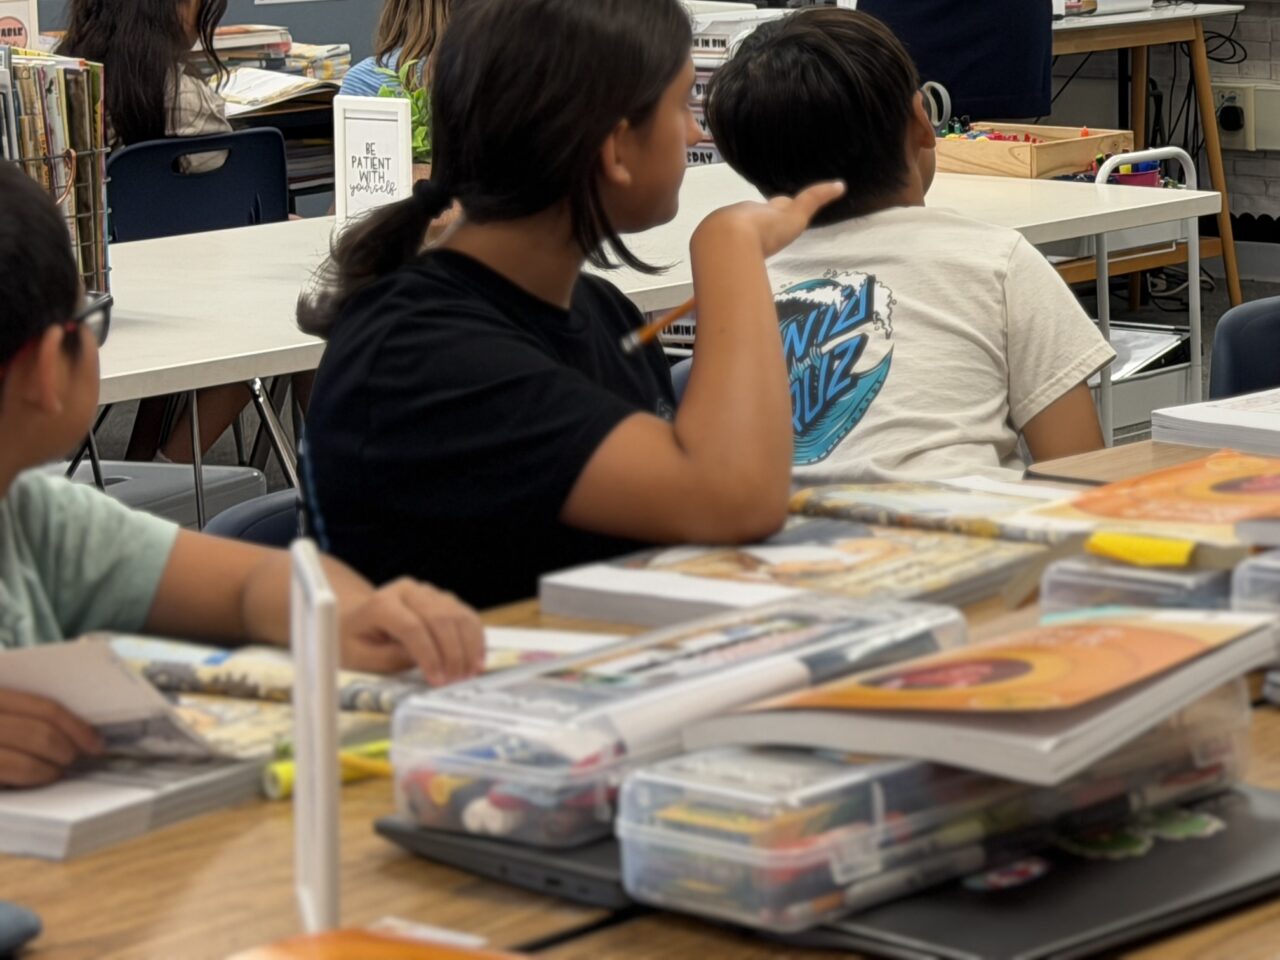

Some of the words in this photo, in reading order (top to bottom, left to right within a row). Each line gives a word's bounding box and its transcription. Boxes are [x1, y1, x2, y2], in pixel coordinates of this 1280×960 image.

[365, 142, 376, 155] BE
[351, 156, 392, 170] PATIENT
[359, 170, 385, 183] WITH
[349, 180, 397, 196] yourself
